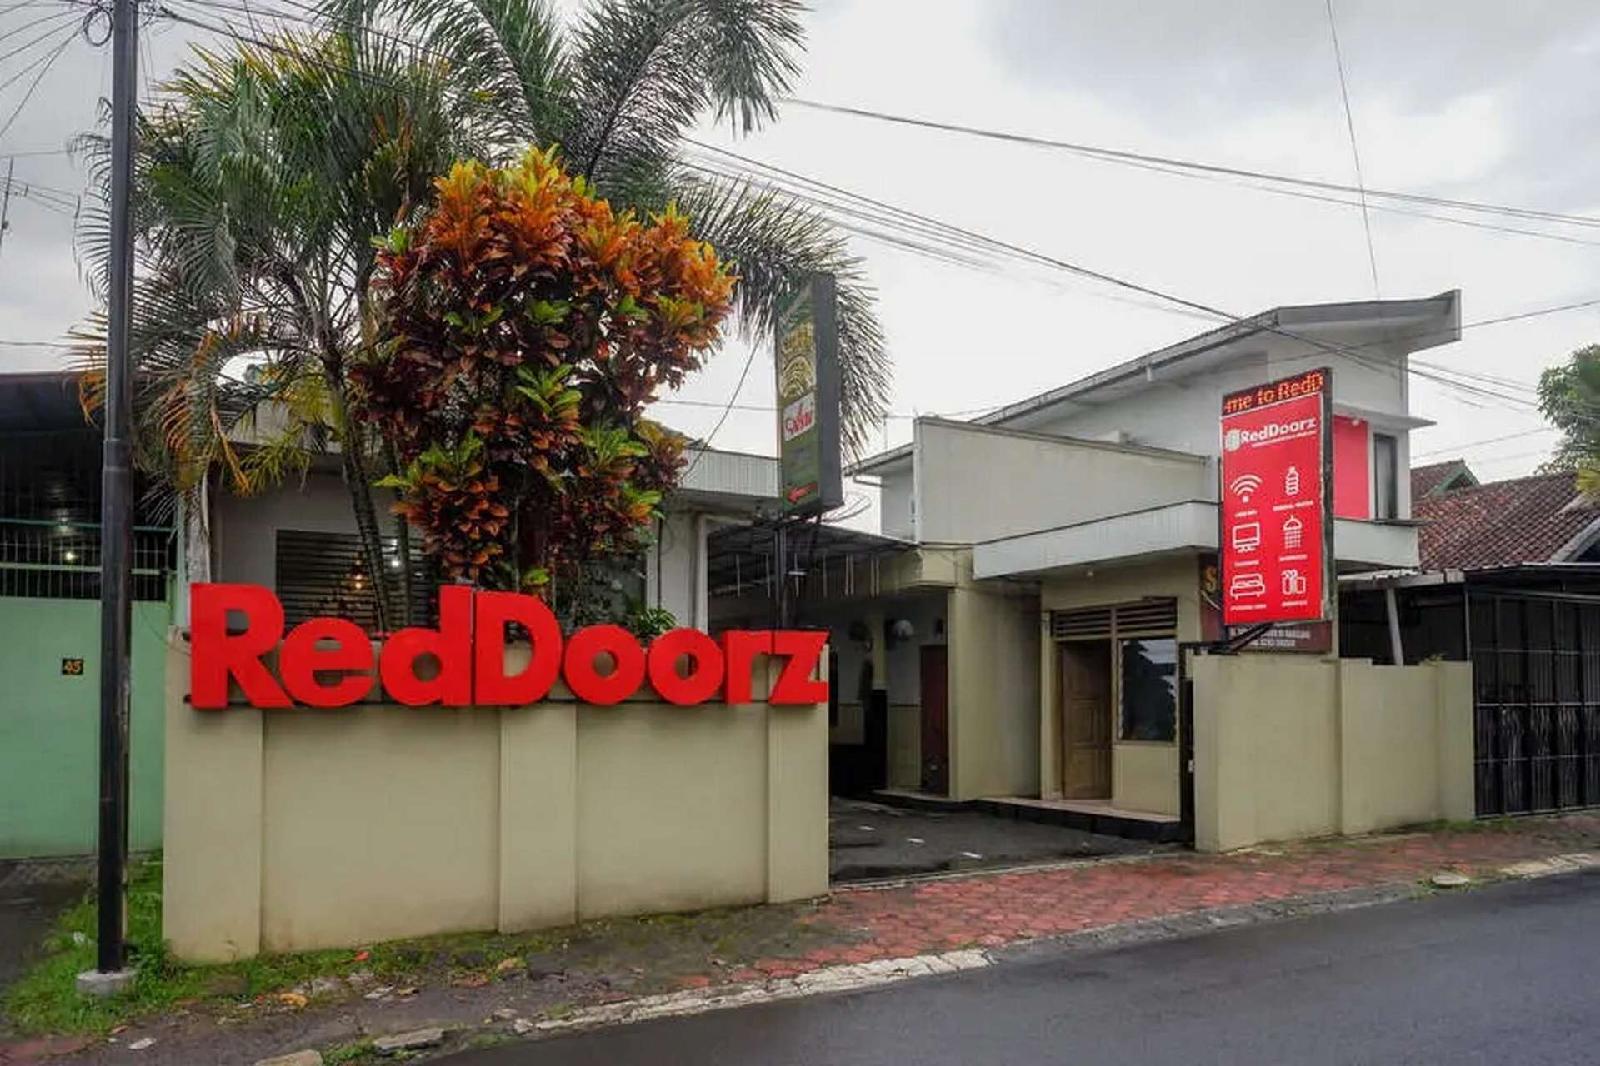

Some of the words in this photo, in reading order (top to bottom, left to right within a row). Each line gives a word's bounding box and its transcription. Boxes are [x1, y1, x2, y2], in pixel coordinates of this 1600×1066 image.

[1258, 388, 1275, 405] to
[1241, 417, 1318, 443] RedDoorz
[189, 582, 830, 709] RedDoorz
